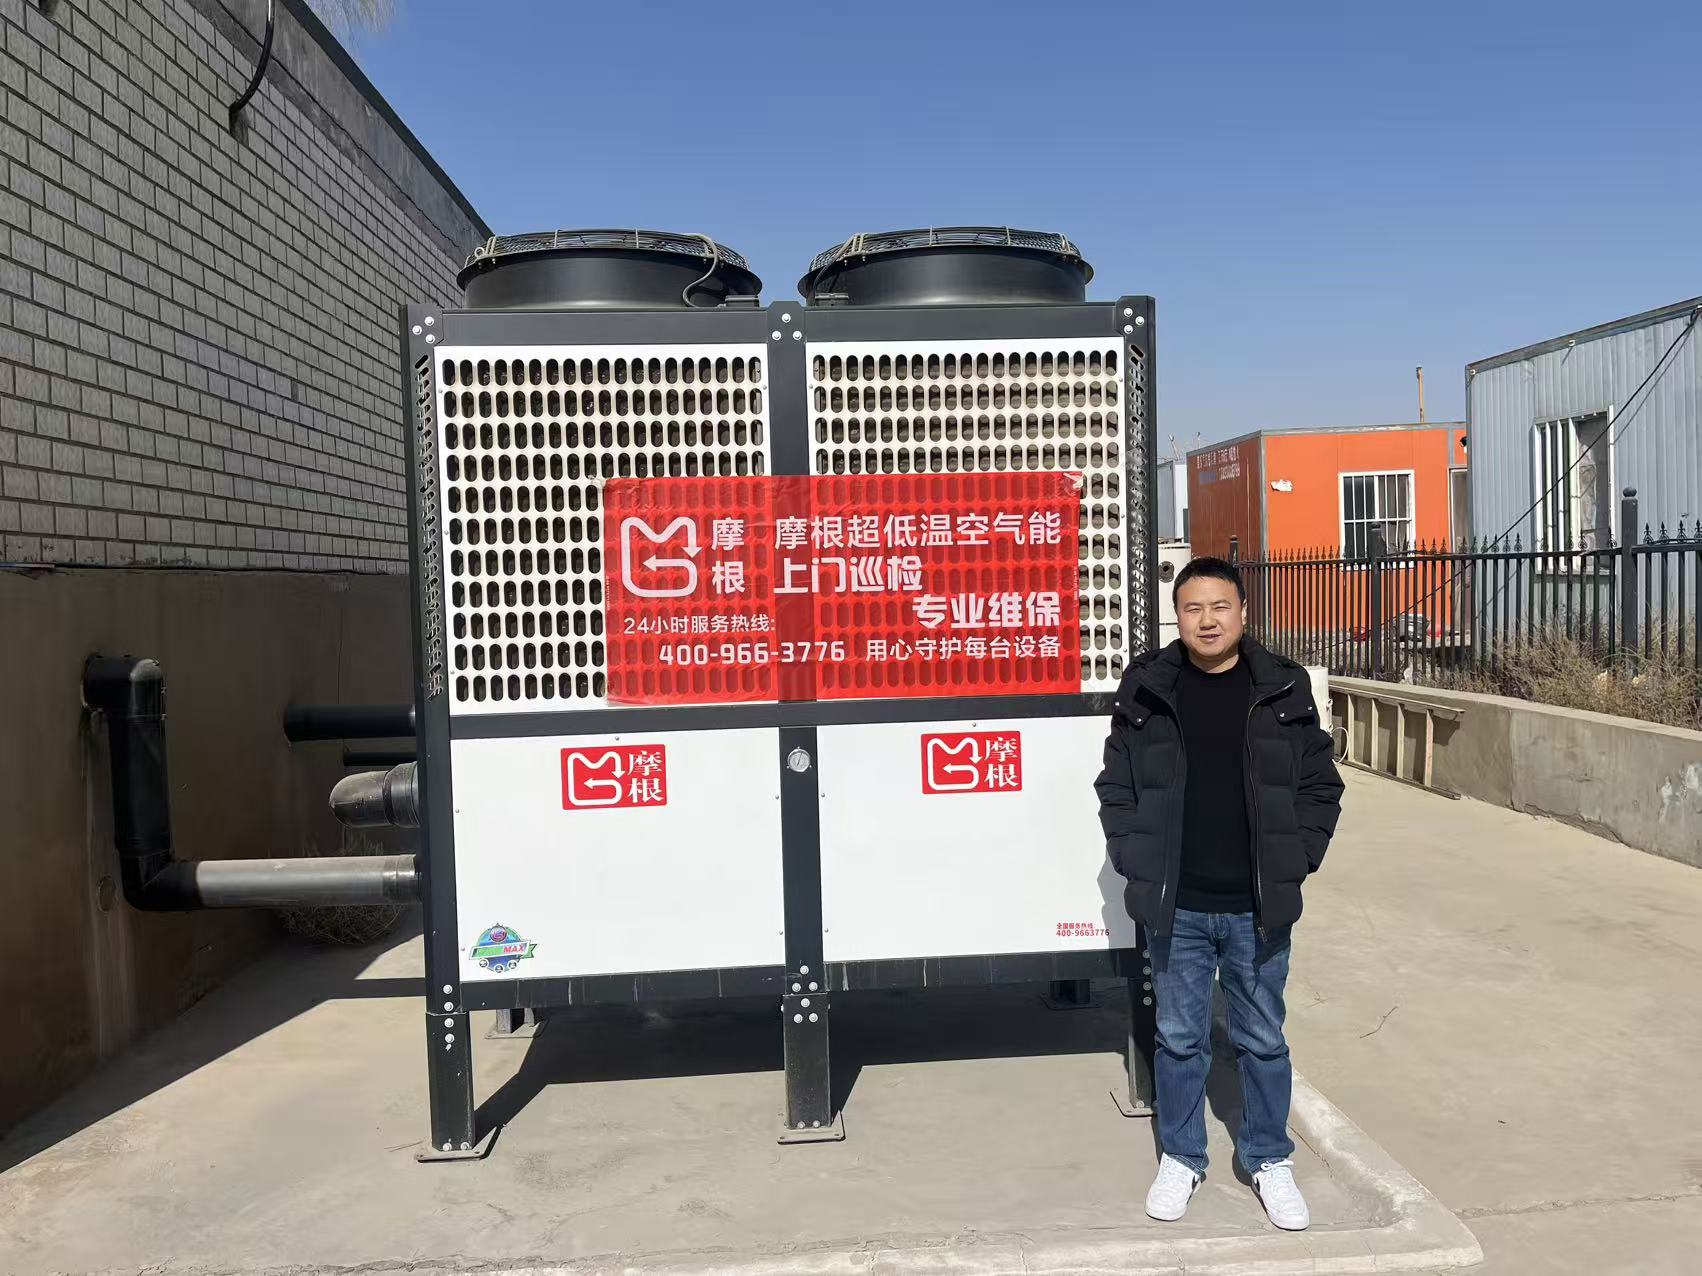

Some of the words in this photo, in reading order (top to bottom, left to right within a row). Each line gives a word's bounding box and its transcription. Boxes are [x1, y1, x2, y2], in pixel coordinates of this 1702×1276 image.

[774, 511, 1061, 550] 摩根超低温空气能
[773, 555, 923, 594] 上门巡检
[623, 614, 775, 635] 24小时服务热线:
[912, 591, 1061, 629] 专业维保
[658, 641, 846, 666] 400-966-3776
[865, 635, 1061, 662] 用心守护每台设备
[627, 750, 664, 803] 摩根
[984, 736, 1018, 789] 摩根
[503, 944, 524, 954] MAX
